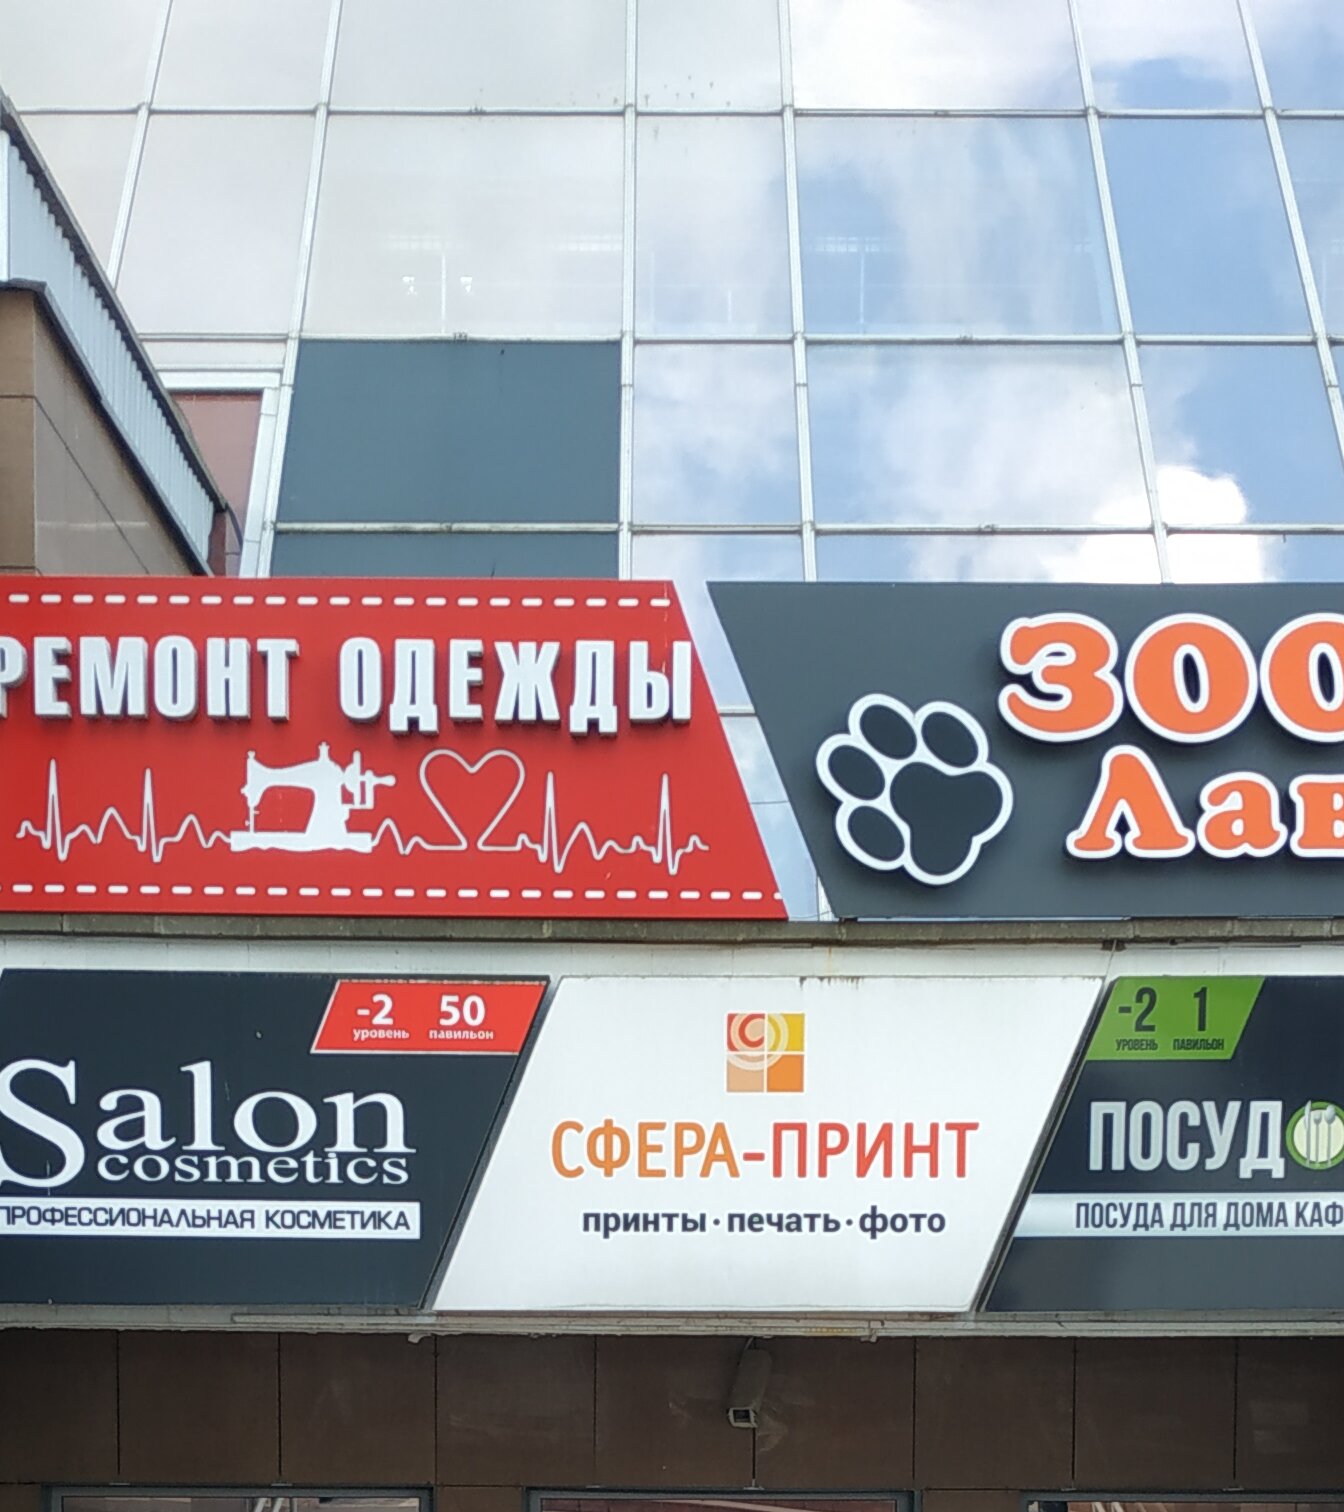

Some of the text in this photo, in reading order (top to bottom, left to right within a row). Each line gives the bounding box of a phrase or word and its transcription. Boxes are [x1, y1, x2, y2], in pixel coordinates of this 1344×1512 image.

[339, 637, 694, 737] ОДЕЖДЫ
[357, 993, 485, 1026] -2 50
[1118, 986, 1208, 1032] -2 1
[353, 1029, 493, 1041] уровень павильон
[1115, 1039, 1224, 1051] УРОВЕНЬ ПАВИЛЬОН
[551, 1119, 979, 1178] СФЕРА-ПРИНТ
[96, 1150, 409, 1185] cosmetics
[265, 1209, 410, 1231] КОСМЕТИКА
[1076, 1202, 1164, 1232] ПОСУДА
[1170, 1202, 1217, 1232] ДЛЯ
[1223, 1201, 1289, 1231] ДОМА
